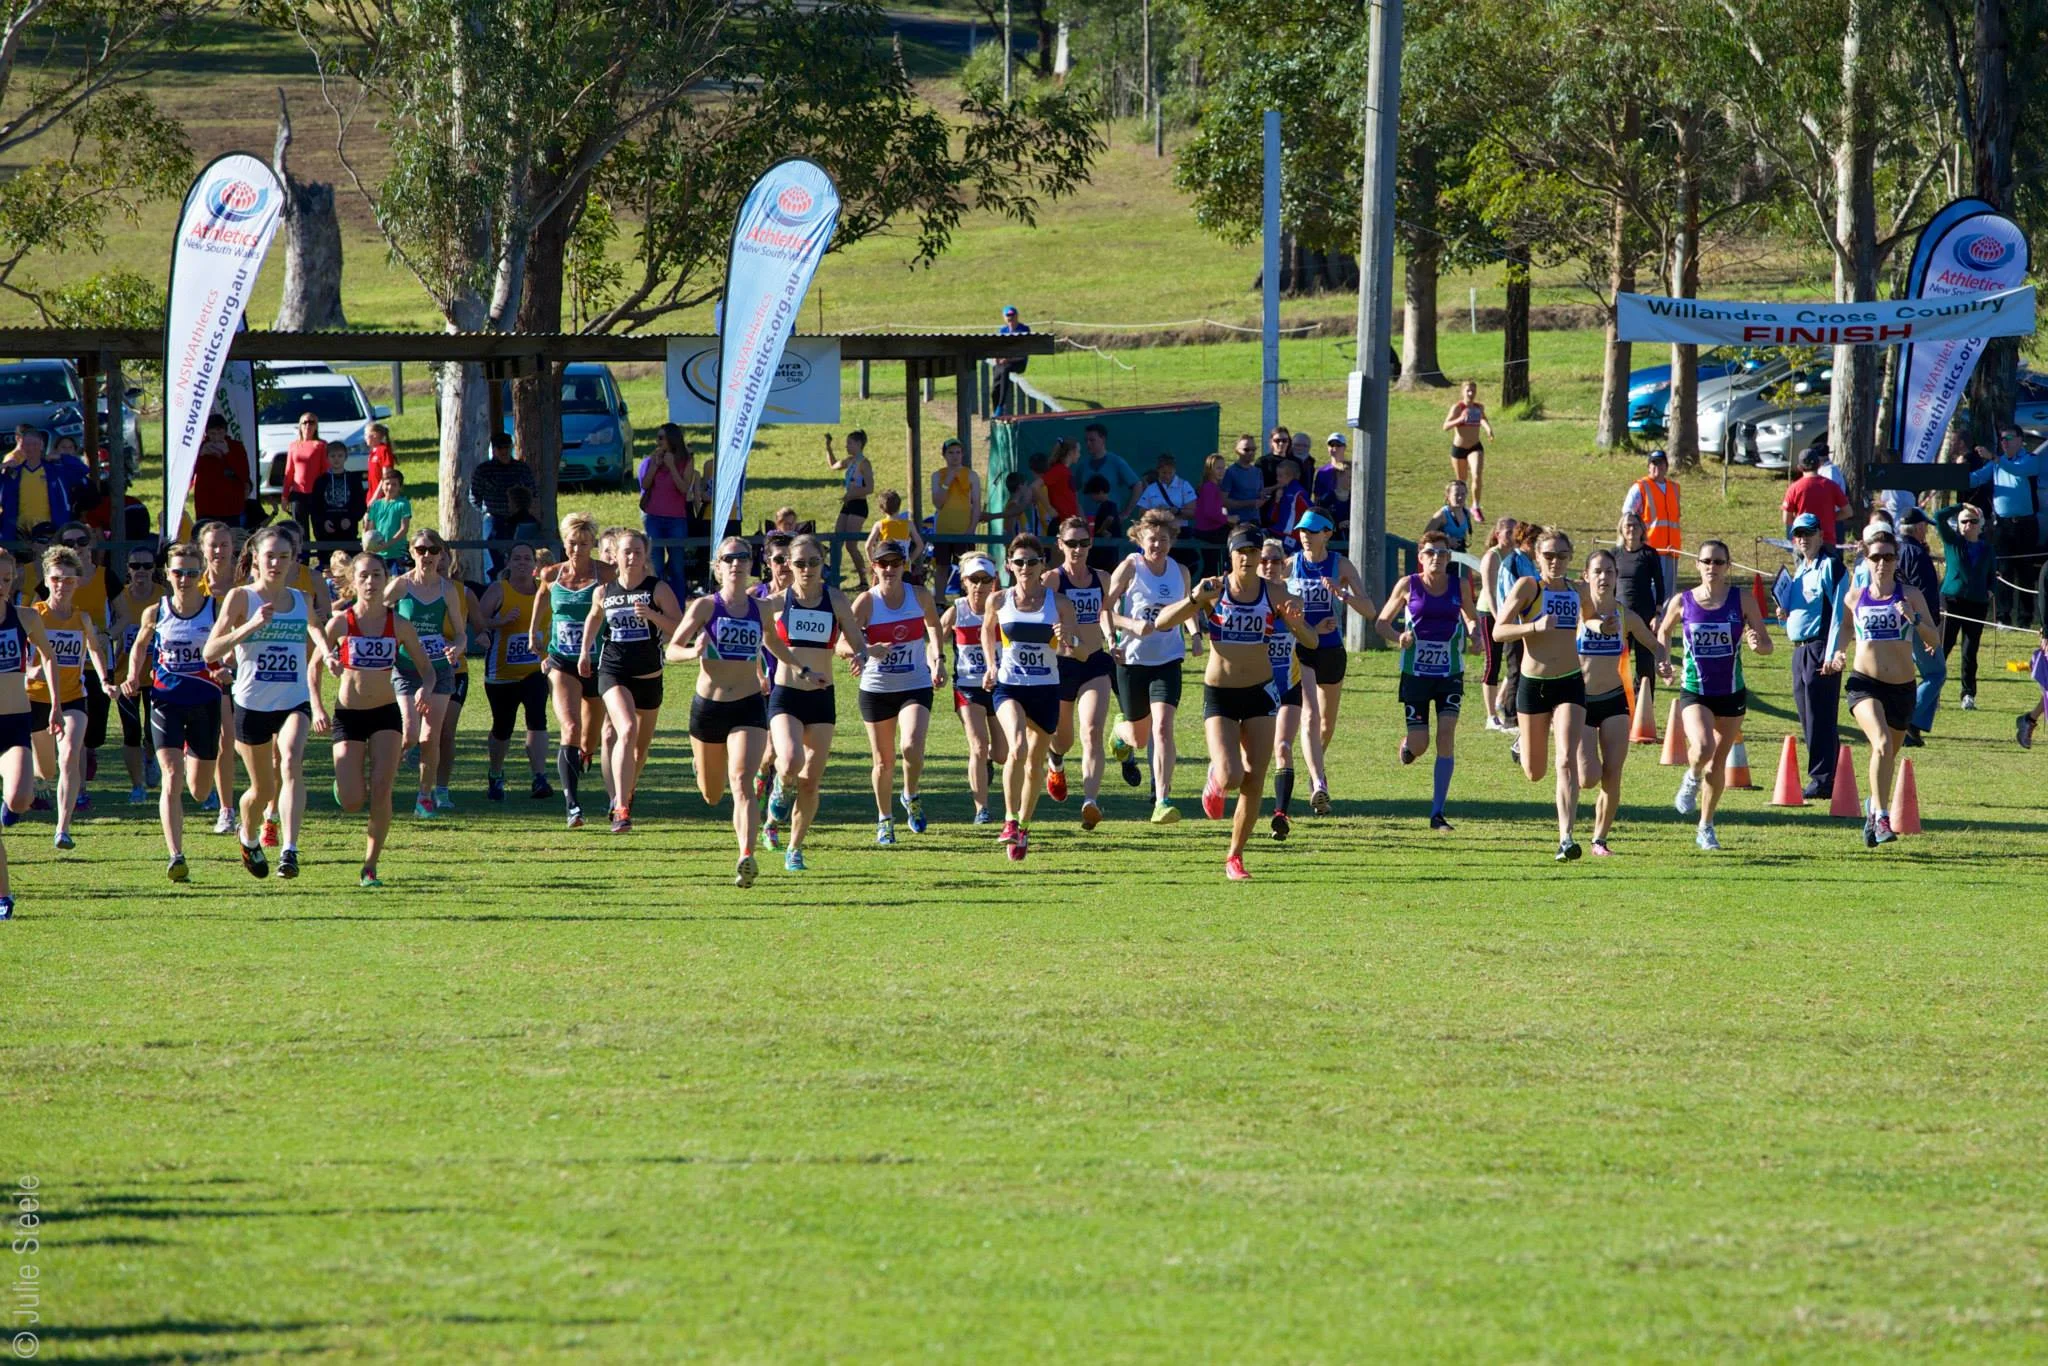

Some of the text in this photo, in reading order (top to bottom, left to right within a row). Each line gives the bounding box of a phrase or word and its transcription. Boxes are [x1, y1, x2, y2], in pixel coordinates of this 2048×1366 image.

[191, 221, 259, 248] Athletics
[184, 238, 204, 250] New
[204, 243, 232, 255] South
[738, 241, 760, 254] New
[761, 245, 789, 260] South
[1929, 283, 1951, 296] New
[1648, 298, 2005, 324] Willandra Cross Country
[1743, 324, 1913, 344] FINISH
[182, 268, 248, 447] nswathletics.org.au
[730, 272, 801, 449] nswathletics.org.au
[1917, 336, 1981, 461] nswathletics.org
[1546, 600, 1578, 616] 5668
[611, 615, 646, 629] 3463
[796, 620, 826, 633] 8020
[1225, 615, 1263, 631] 4120
[1863, 613, 1897, 629] 2293
[252, 630, 305, 640] Striders
[560, 629, 584, 644] 312
[721, 627, 758, 645] 2266
[1694, 632, 1729, 645] 2276
[508, 640, 531, 656] 560
[1268, 642, 1292, 656] 856
[1417, 648, 1449, 664] 2273
[257, 653, 298, 671] 5226
[1019, 651, 1044, 666] 901
